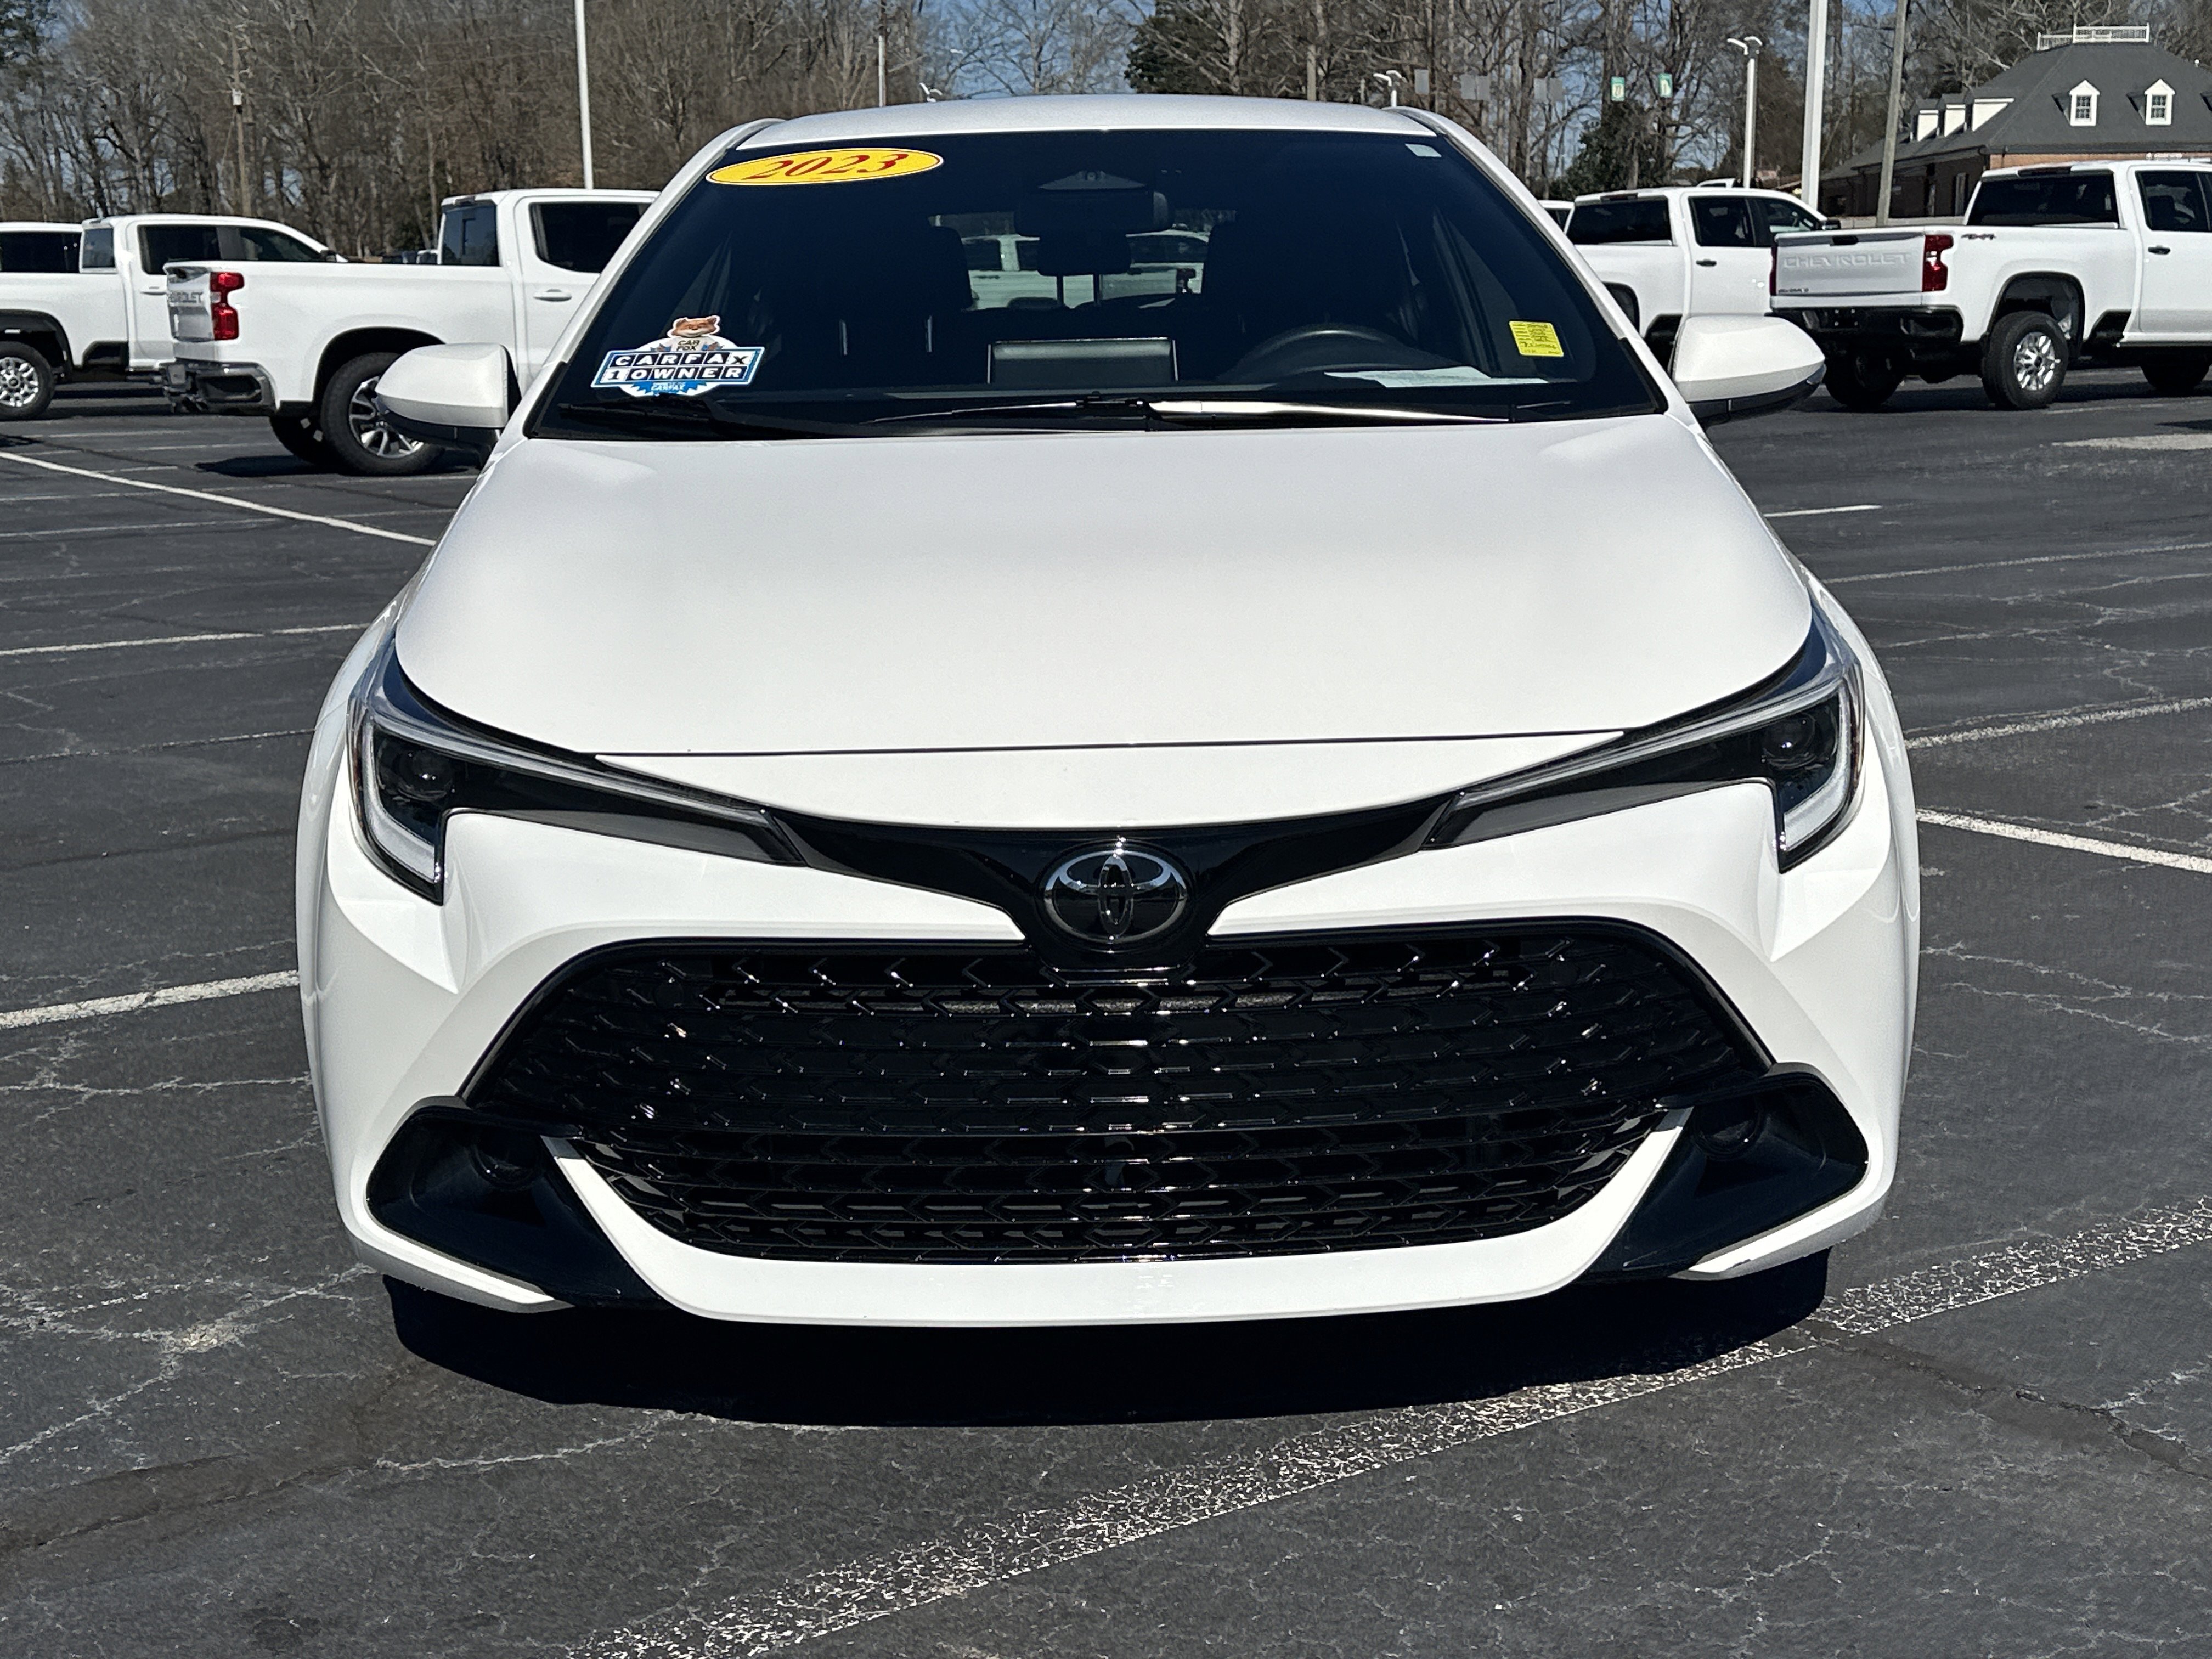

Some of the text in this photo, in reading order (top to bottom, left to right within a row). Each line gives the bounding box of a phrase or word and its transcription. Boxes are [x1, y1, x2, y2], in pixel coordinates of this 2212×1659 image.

[742, 153, 909, 180] 2023
[1783, 252, 1911, 268] CHEVROLET
[614, 353, 749, 366] CARFAX
[607, 367, 741, 380] 1 OWNER
